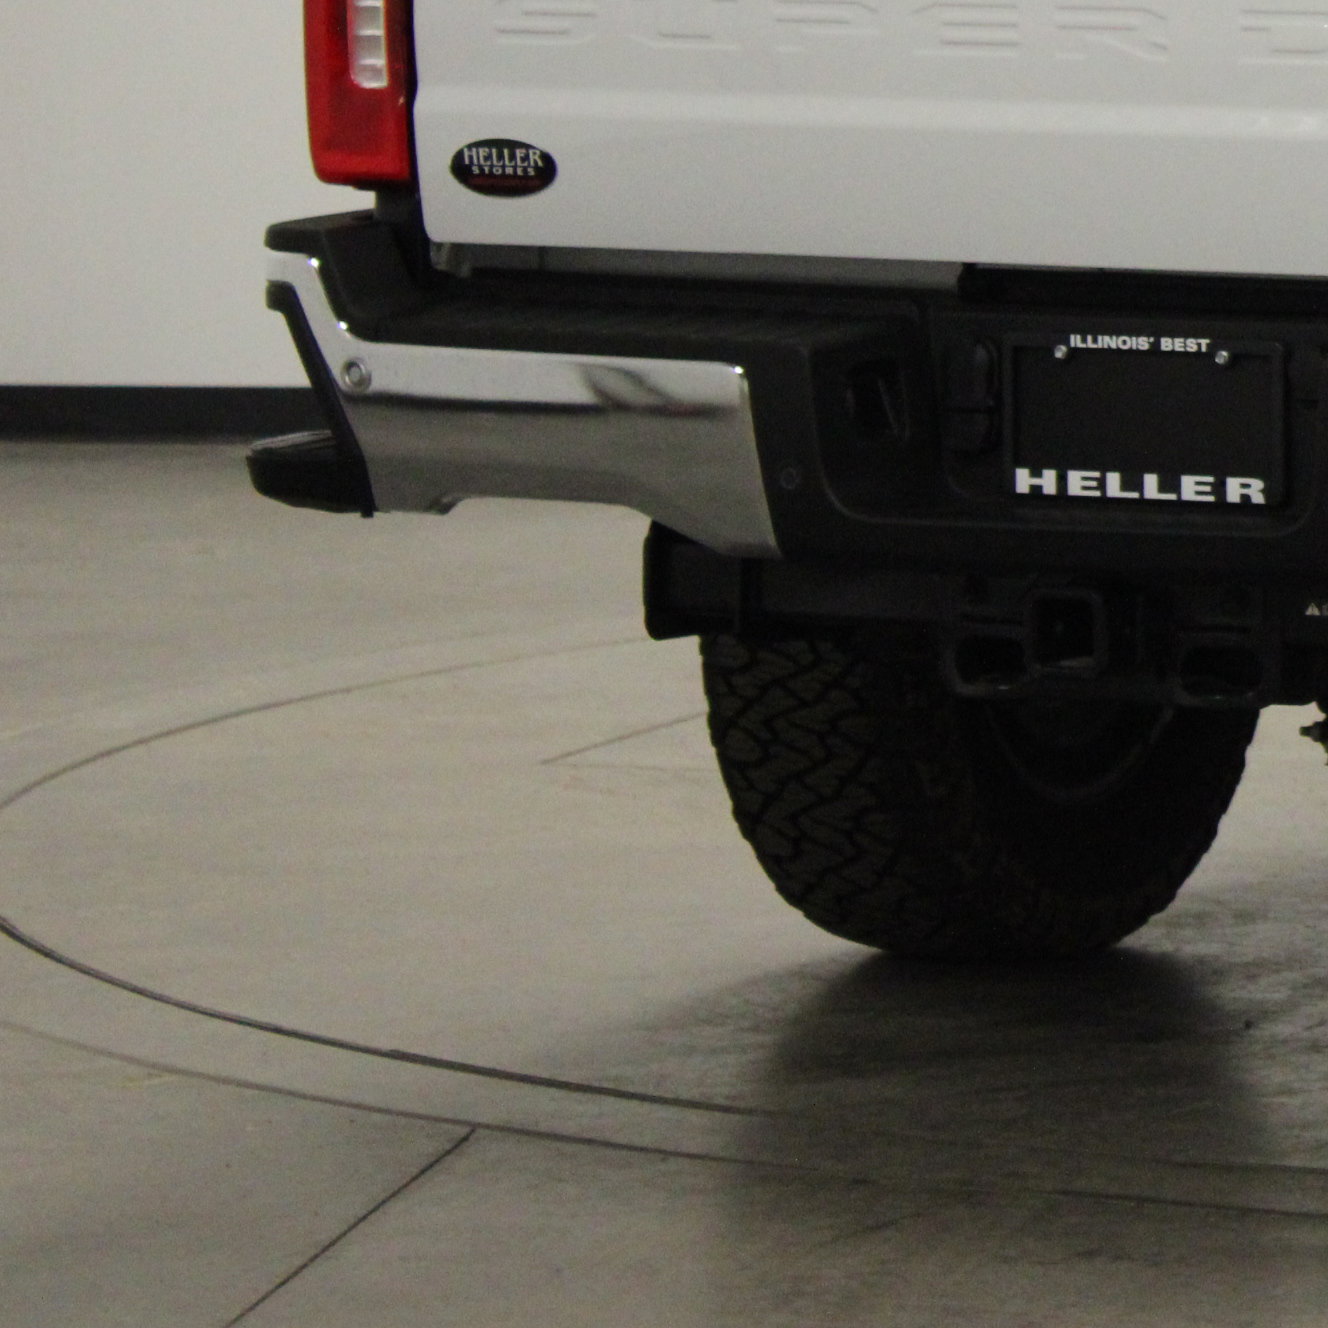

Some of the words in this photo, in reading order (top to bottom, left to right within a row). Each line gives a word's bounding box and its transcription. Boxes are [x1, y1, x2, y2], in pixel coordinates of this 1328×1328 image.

[462, 147, 544, 167] HELLER
[471, 166, 535, 176] STORES
[1159, 337, 1211, 353] BEST
[1014, 468, 1267, 505] HELLER
